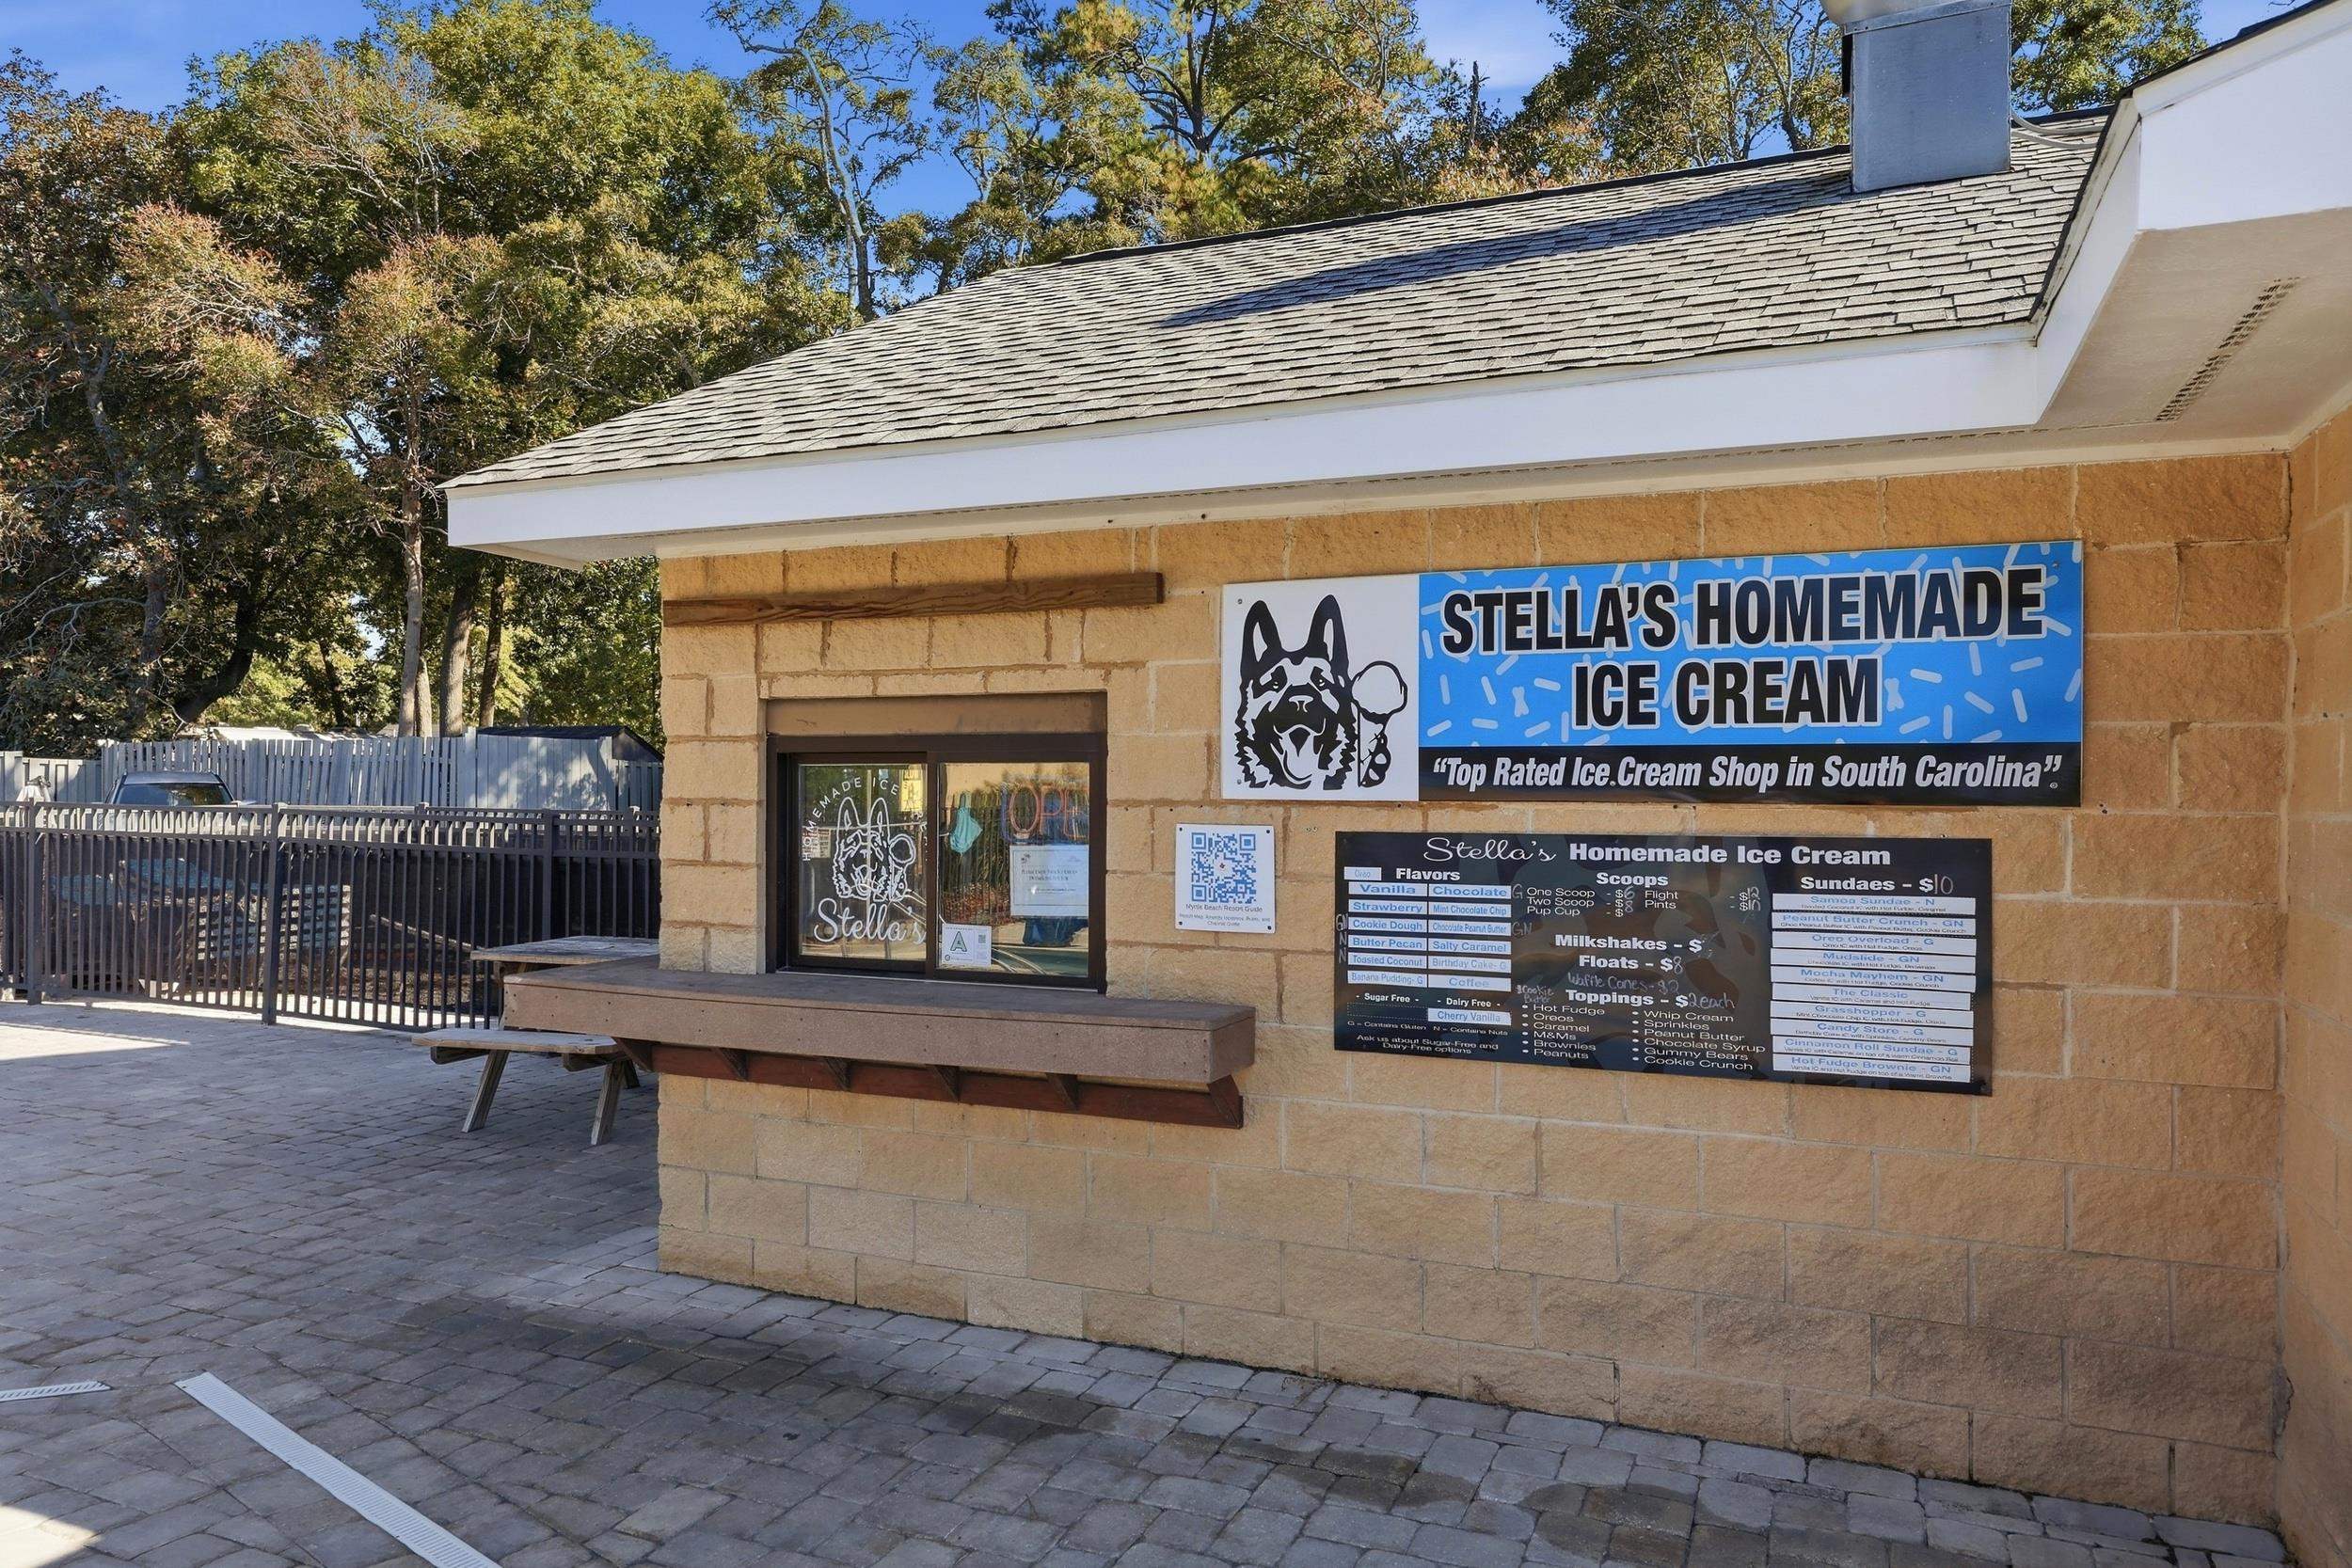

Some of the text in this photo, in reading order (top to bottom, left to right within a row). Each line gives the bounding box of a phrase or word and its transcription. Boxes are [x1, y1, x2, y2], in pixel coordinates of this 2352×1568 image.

[1442, 567, 2044, 653] STELLA'S HOMEMADE
[1575, 658, 1880, 728] ICE CREAM
[1494, 755, 1561, 787] Rated
[1571, 756, 1610, 787] Ice
[1617, 756, 1701, 787] Cream
[1709, 755, 1775, 792] Shop
[1786, 755, 1813, 785] in
[1822, 755, 1905, 786] South
[1009, 785, 1089, 839] OPE
[803, 777, 862, 862] HOMEMADE
[873, 777, 899, 796] ICE
[1423, 837, 1891, 864] Stella's Homemade Ice Cream
[1396, 868, 1460, 880] Flavors
[1597, 872, 1668, 887] Scoops
[1359, 884, 1416, 894] Vanilla
[1801, 876, 1895, 891] Sundaes
[1433, 886, 1506, 896] Chocolate
[1527, 887, 1551, 896] One
[1555, 888, 1595, 899] Scoop
[1645, 890, 1678, 901] Flight
[1527, 897, 1550, 906] Two
[1554, 898, 1595, 908] Scoop
[1645, 900, 1677, 910] Pints
[1810, 895, 1856, 904] Samoa
[1861, 896, 1911, 905] Sundae
[1353, 902, 1422, 913] Strawberry
[1451, 905, 1487, 914] Chocolate
[1489, 906, 1506, 915] Chip
[1527, 906, 1550, 915] Pup
[1554, 908, 1580, 916] Cup
[1353, 920, 1422, 930] Cookie Dough
[1783, 914, 1828, 923] Peanut
[1834, 916, 1875, 925] Butter
[1879, 917, 1928, 927] Crunch
[1433, 924, 1463, 932] Chocolate
[950, 931, 967, 952] A
[1353, 938, 1422, 948] Butter Pecan
[1555, 934, 1667, 950] Milkshakes
[1812, 934, 1846, 942] Oreo
[1849, 935, 1909, 944] Overload
[1433, 942, 1506, 952] Salty Caramel
[1353, 956, 1422, 966] Toasted Coconut
[1822, 952, 1883, 961] Mudslide
[1433, 958, 1469, 968] Birthday
[1579, 955, 1638, 970] Floats
[1351, 973, 1380, 981] Banana
[1801, 968, 1846, 977] Mocha
[1850, 971, 1908, 981] Mayhem
[1923, 974, 1944, 983] GN
[1449, 977, 1489, 988] Coffee
[1364, 992, 1410, 1003] Sugar Free
[1565, 989, 1654, 1006] Toppings
[1833, 988, 1908, 999] The Classic
[1446, 998, 1491, 1007] Dairy Free
[1438, 1011, 1500, 1022] Cherry Vanilla
[1562, 1006, 1605, 1016] Fudge
[1645, 1010, 1734, 1022] Whip Cream
[1815, 1005, 1901, 1018] Grasshopper
[1534, 1013, 1574, 1022] Oreos
[1534, 1022, 1589, 1033] Caramel
[1645, 1020, 1709, 1031] Sprinkles
[1817, 1022, 1858, 1033] Candy
[1863, 1025, 1899, 1035] Store
[1534, 1031, 1576, 1040] M&Ms
[1645, 1029, 1745, 1041] Peanut Butter
[1392, 1037, 1419, 1045] about
[1422, 1038, 1476, 1049] Sugar-Free
[1534, 1039, 1597, 1051] Brownies
[1645, 1037, 1766, 1053] Chocolate Syrup
[1785, 1038, 1850, 1049] Cinnamon
[1854, 1042, 1880, 1051] Roll
[1883, 1044, 1934, 1053] Sundae
[1534, 1049, 1588, 1059] Peanuts
[1645, 1048, 1749, 1060] Gummy Bears
[1645, 1056, 1753, 1070] Cookie Crunch
[1791, 1056, 1815, 1065] Hot
[1819, 1058, 1859, 1069] Fudge
[1863, 1062, 1916, 1071] Brownie
